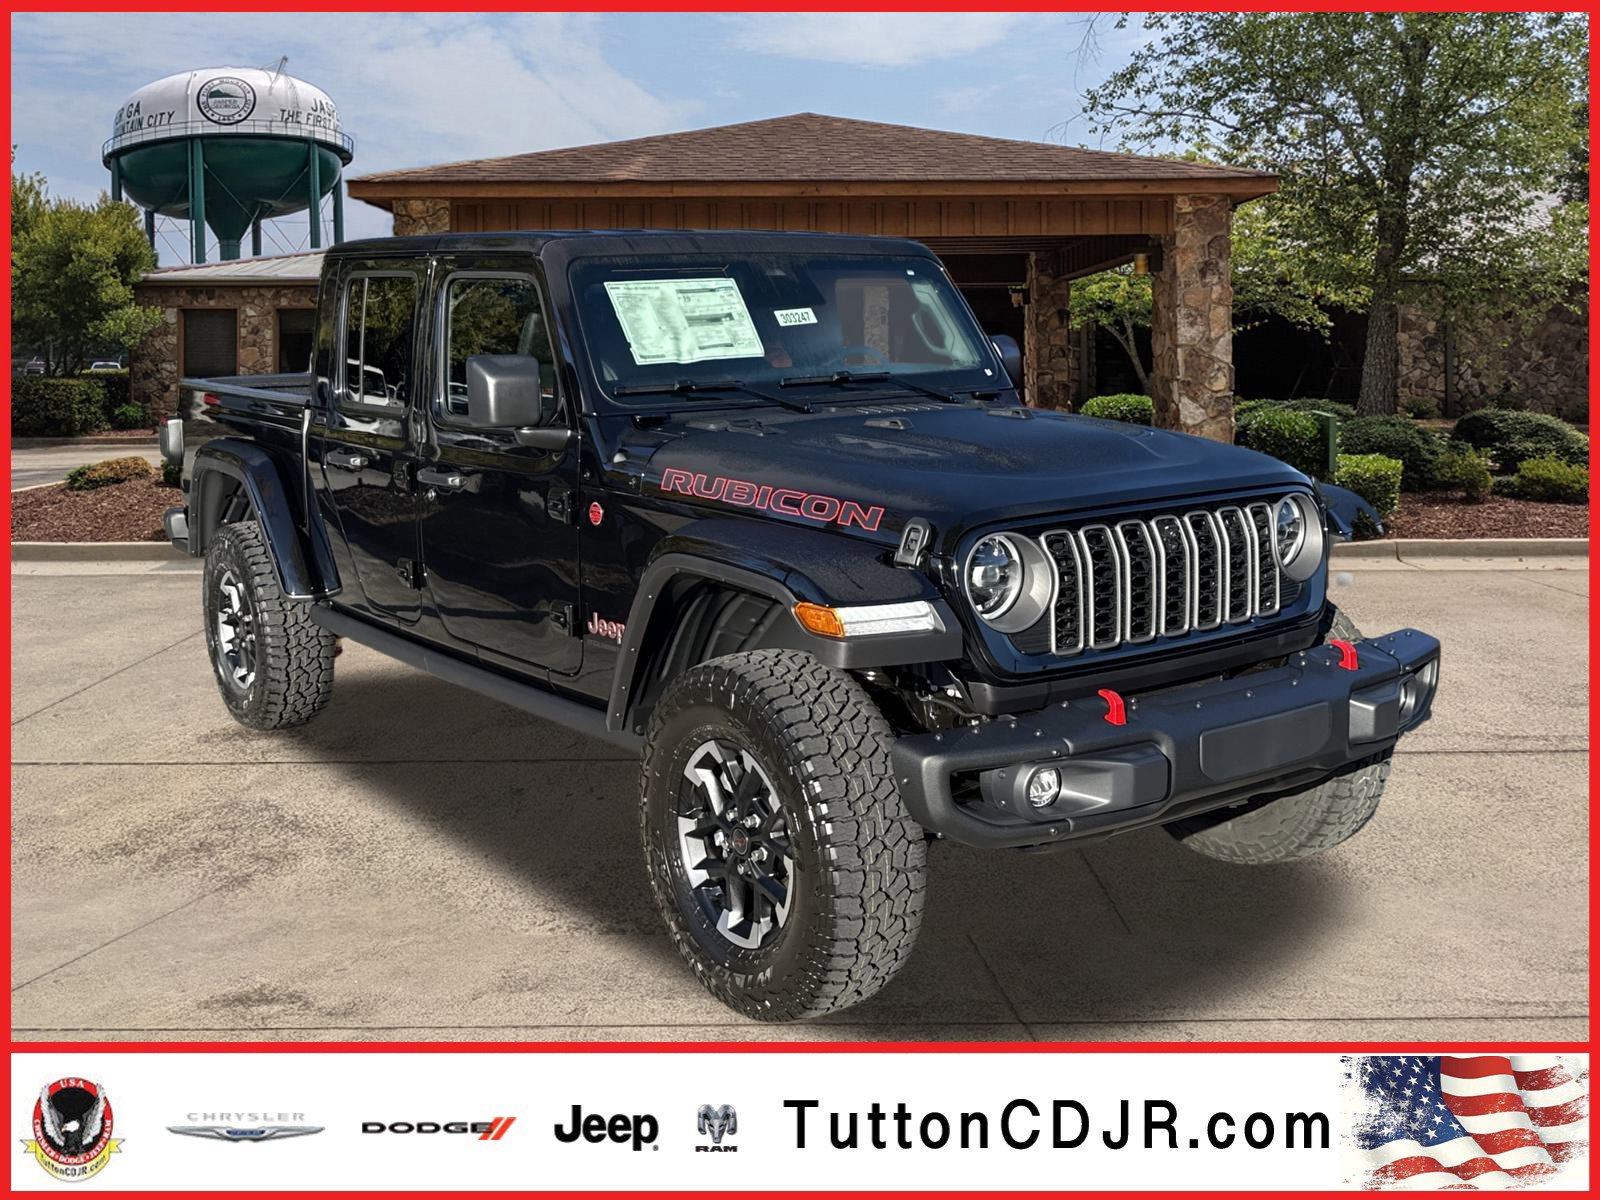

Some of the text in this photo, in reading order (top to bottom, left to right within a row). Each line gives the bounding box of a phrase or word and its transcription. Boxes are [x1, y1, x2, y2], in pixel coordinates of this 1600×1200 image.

[126, 101, 141, 119] GA
[147, 110, 175, 128] CITY
[280, 108, 302, 124] THE
[306, 112, 332, 130] FIRST
[780, 311, 811, 325] 303247
[661, 467, 885, 532] RUBICON
[587, 611, 626, 645] Jeep
